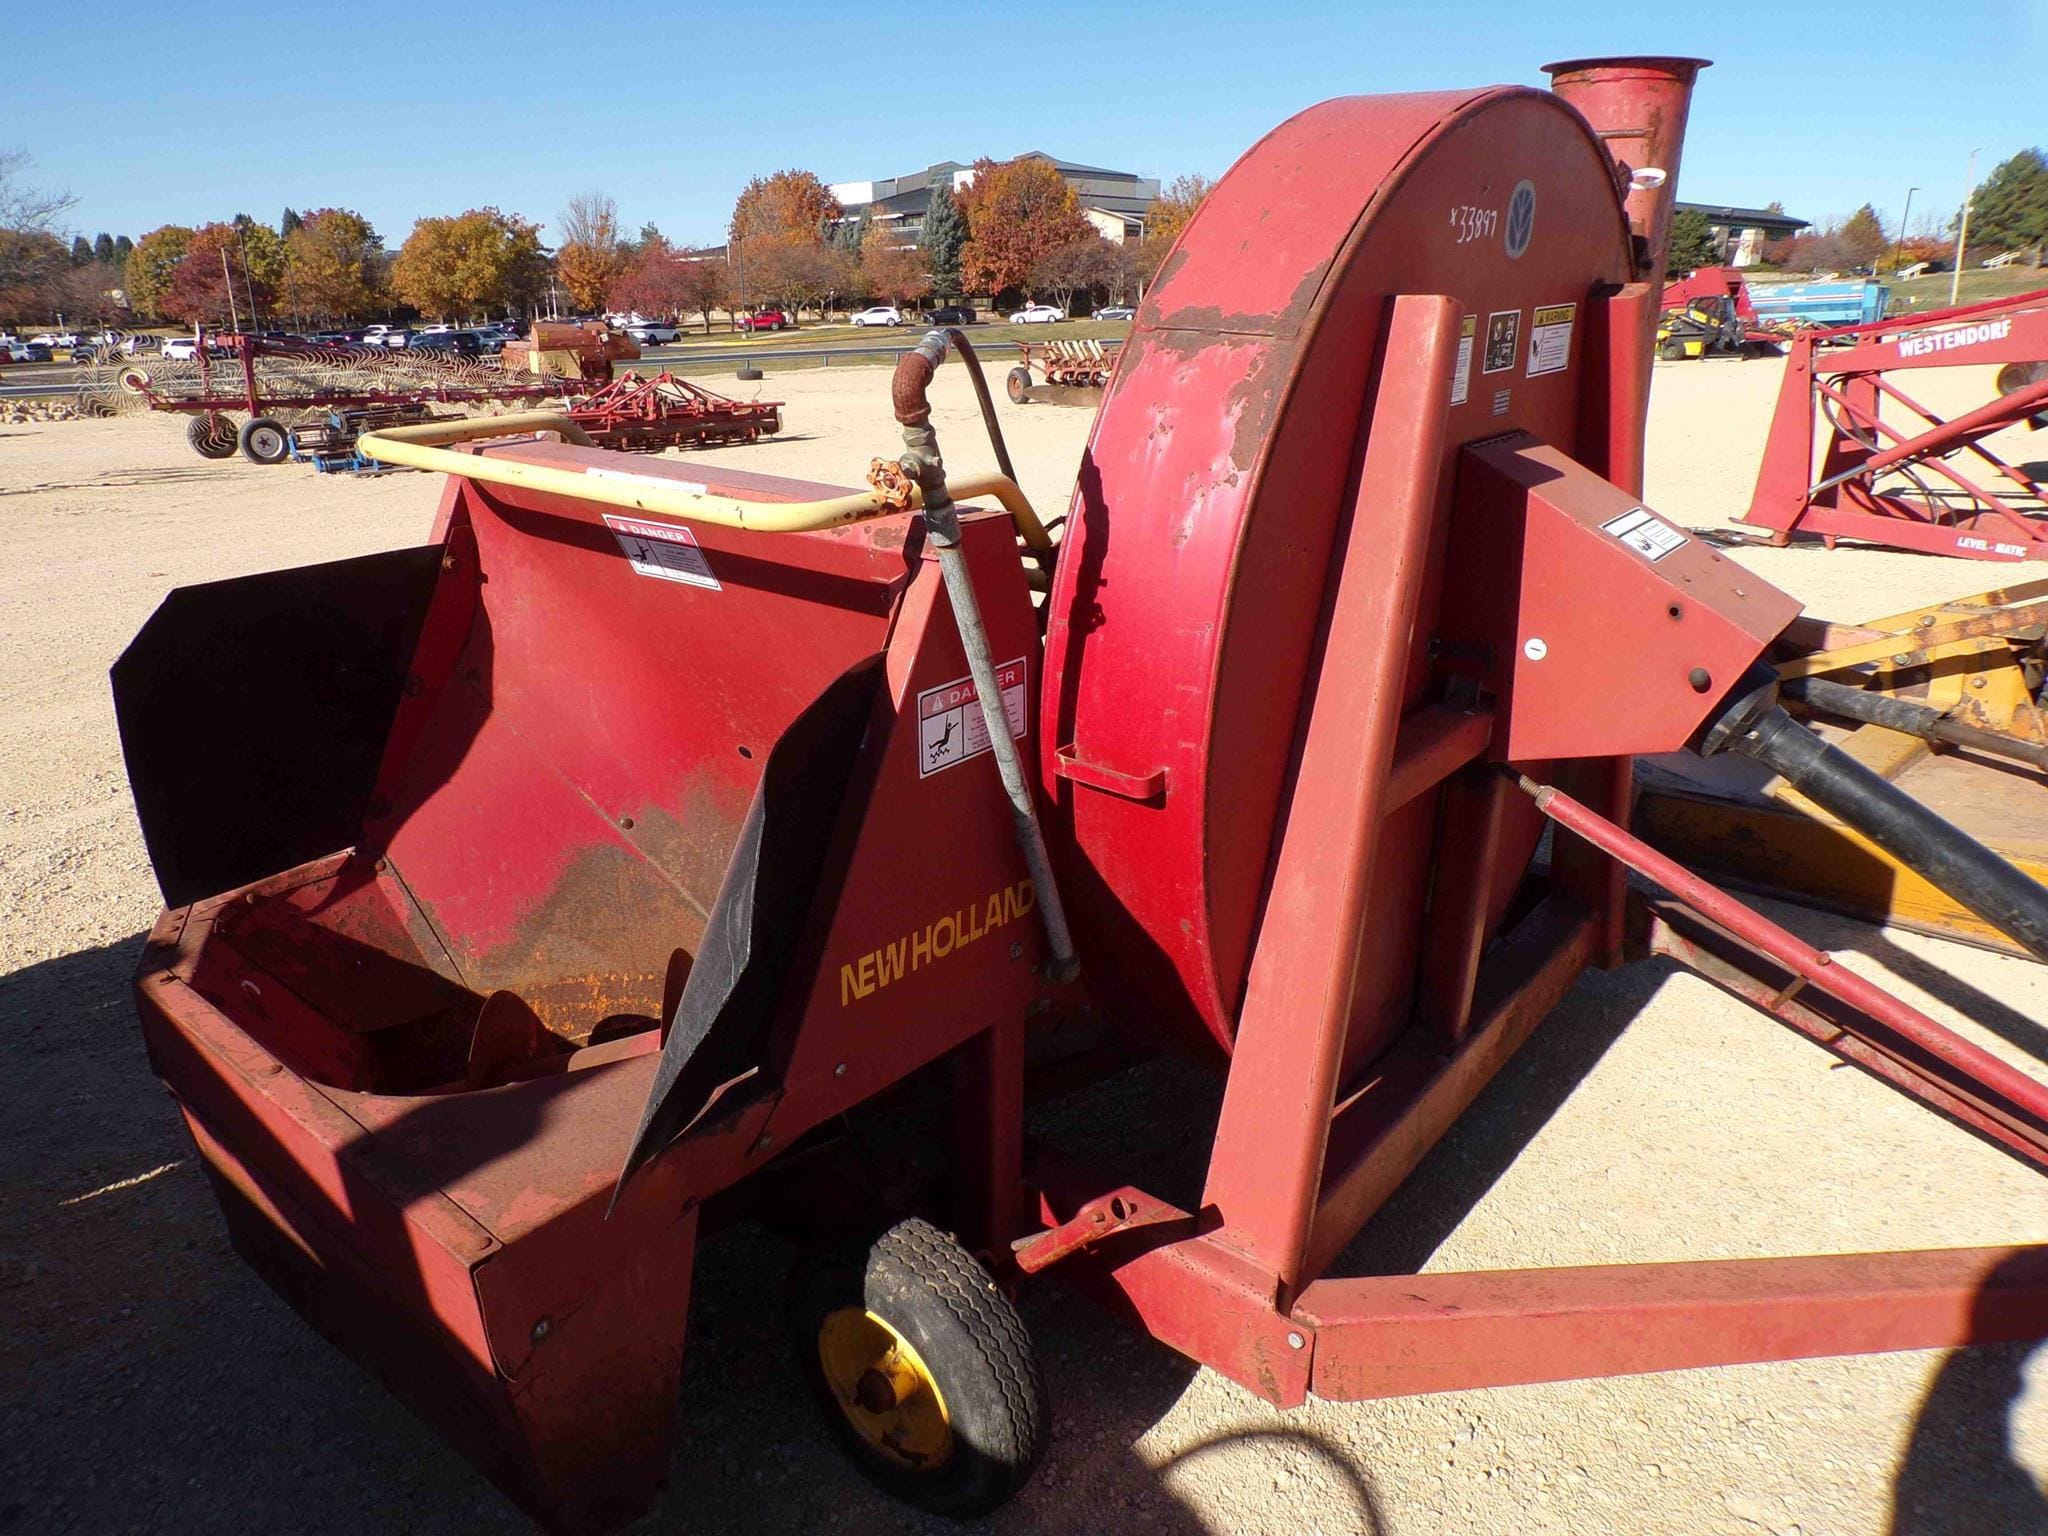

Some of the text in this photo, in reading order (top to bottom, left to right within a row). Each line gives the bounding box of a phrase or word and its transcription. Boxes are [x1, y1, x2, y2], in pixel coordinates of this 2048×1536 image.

[1899, 319, 2012, 358] WESTENDORF
[630, 523, 686, 542] DANGER
[950, 670, 1015, 704] DAER
[840, 879, 1036, 1007] NEW HOLLAND
